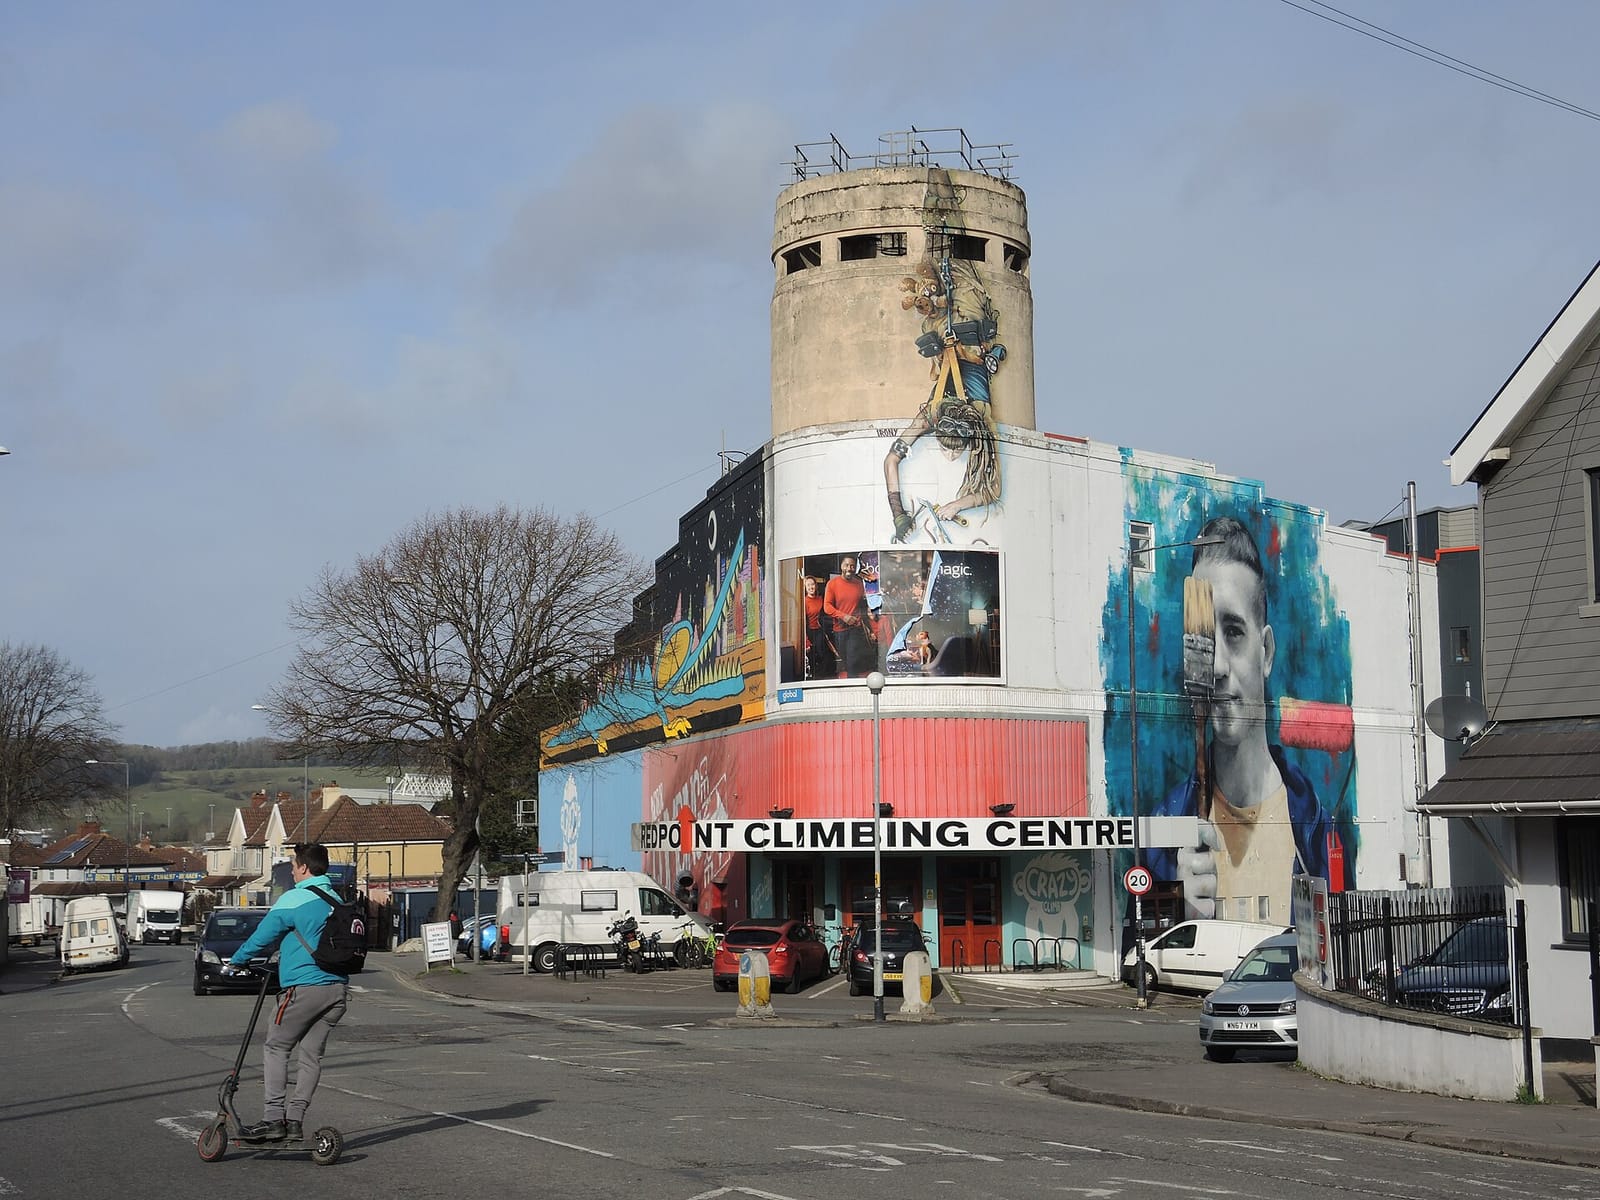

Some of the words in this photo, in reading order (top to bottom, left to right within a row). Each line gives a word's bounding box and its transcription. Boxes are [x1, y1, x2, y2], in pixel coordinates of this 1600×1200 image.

[782, 689, 798, 702] global
[744, 820, 969, 849] CLIMBING
[986, 820, 1133, 847] CENTRE
[1026, 868, 1078, 899] CRAZY
[1130, 874, 1148, 887] 20
